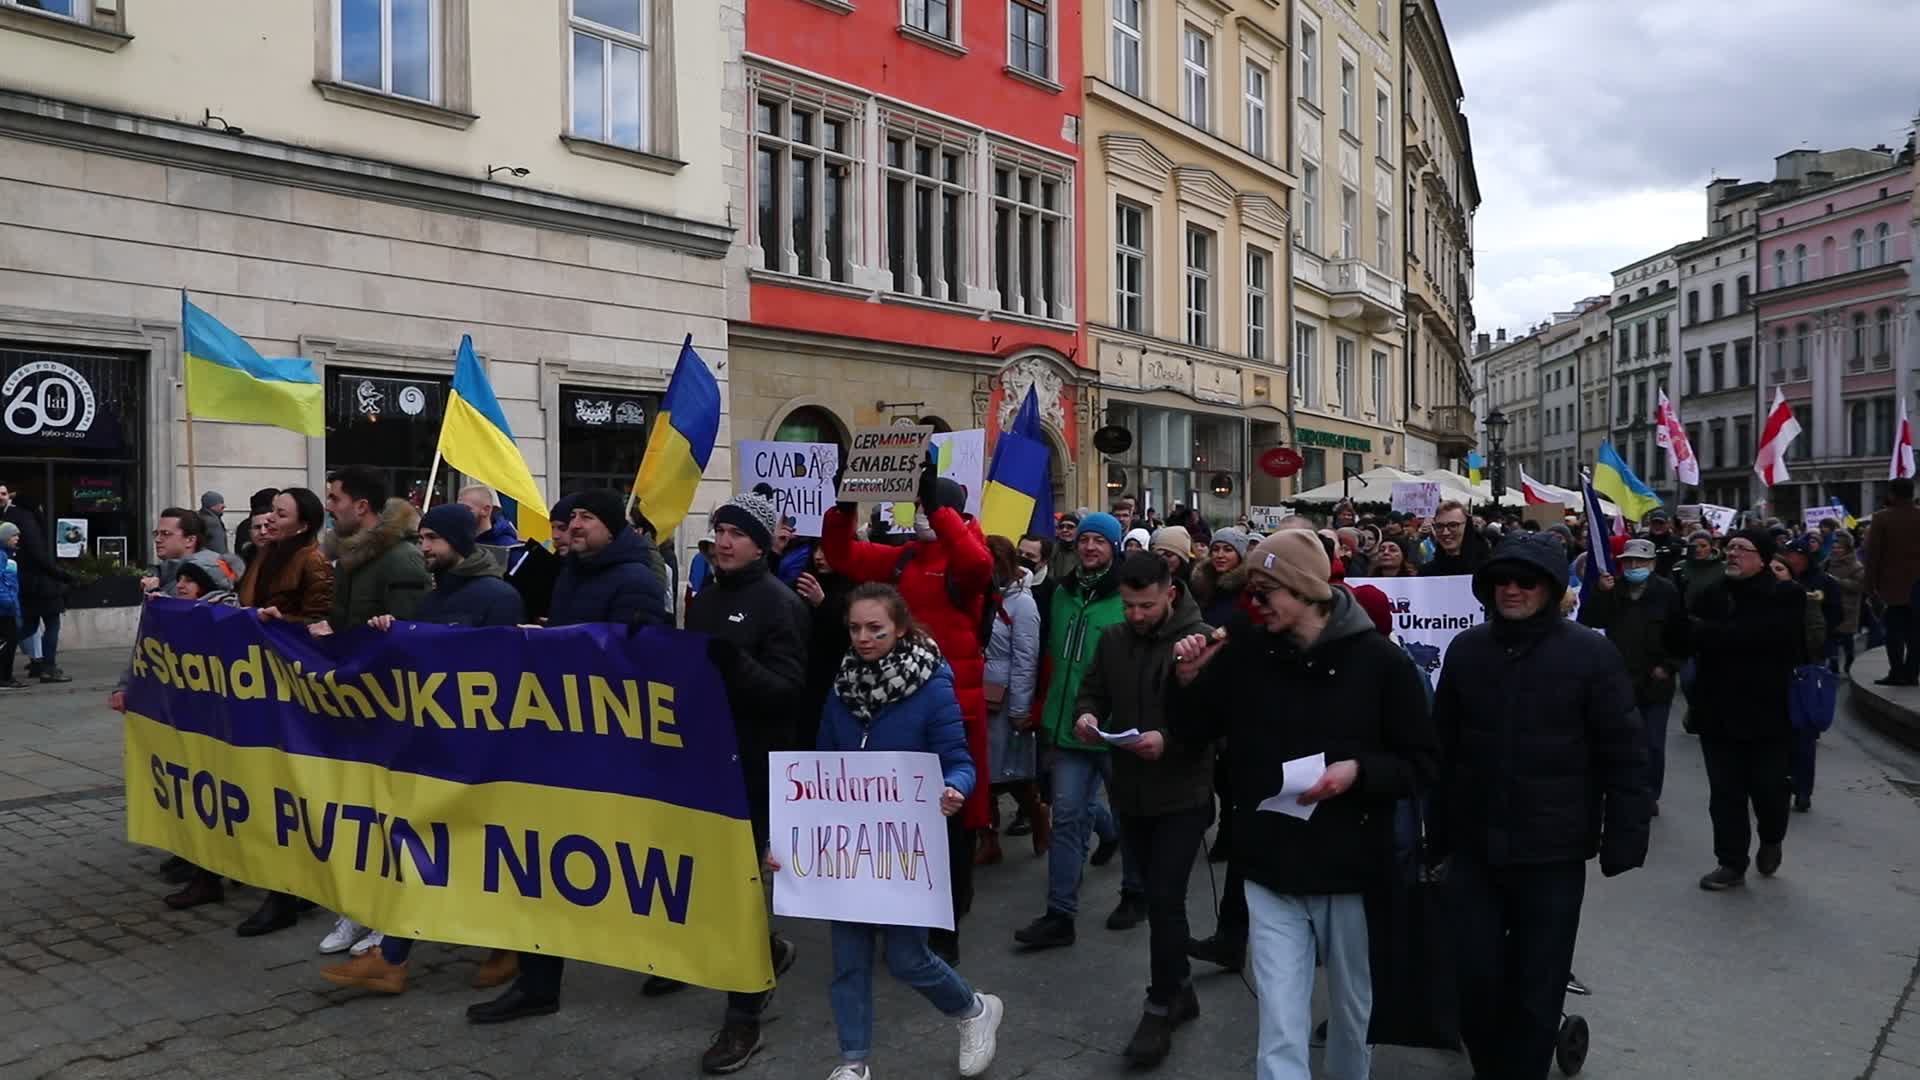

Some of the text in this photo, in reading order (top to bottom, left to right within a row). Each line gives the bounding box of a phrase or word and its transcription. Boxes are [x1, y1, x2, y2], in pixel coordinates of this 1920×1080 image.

[4, 377, 76, 435] 60 lat
[1399, 614, 1474, 630] Ukraine!
[785, 757, 927, 803] Solidarni z
[151, 754, 694, 925] STOP PUTIN NOW
[792, 821, 933, 890] UKRAINĄ
